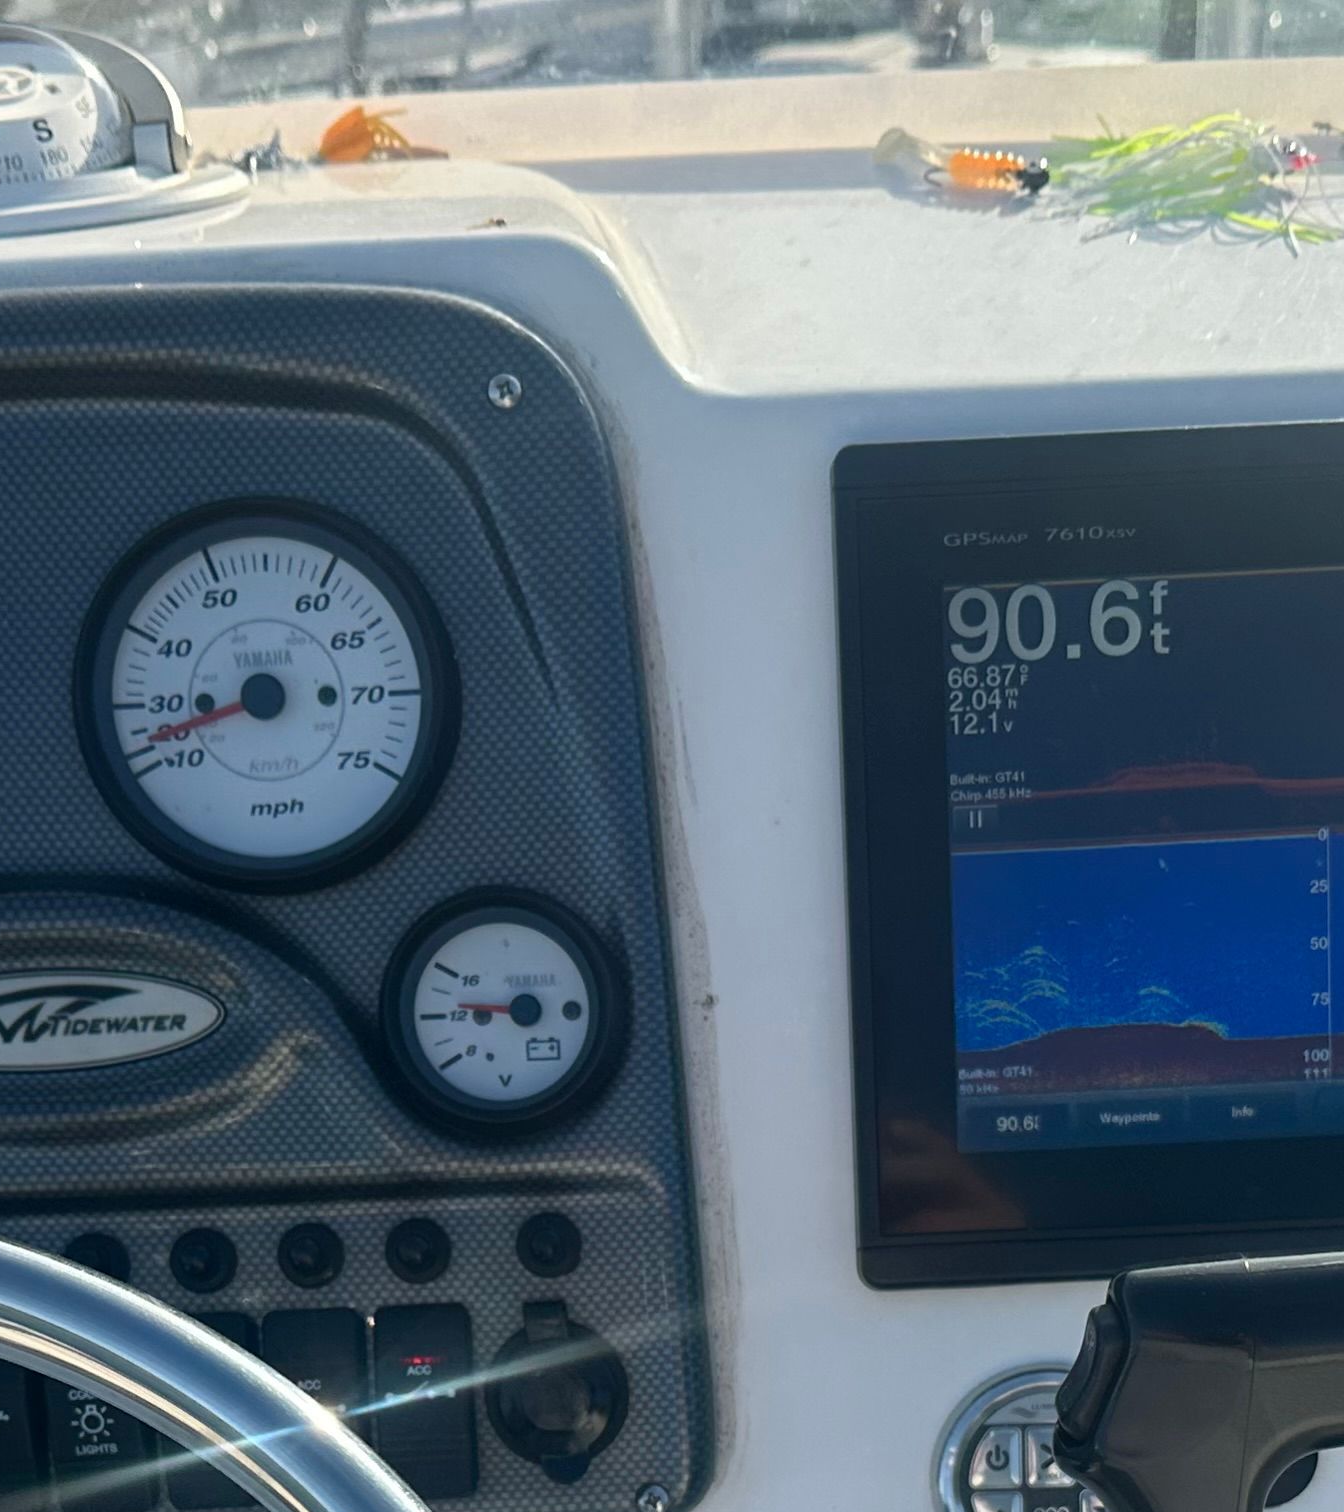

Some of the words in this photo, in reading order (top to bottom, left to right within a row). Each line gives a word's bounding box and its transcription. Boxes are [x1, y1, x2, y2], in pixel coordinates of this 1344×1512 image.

[33, 119, 53, 143] S
[202, 590, 237, 609] 50
[295, 594, 330, 613] 60
[947, 579, 1142, 664] 90.6
[157, 639, 191, 659] 40
[330, 631, 365, 650] 65
[233, 650, 293, 668] YAMAHA
[947, 664, 1016, 689] 66.87
[351, 685, 384, 705] 70
[949, 688, 1001, 713] 2.04
[148, 694, 184, 714] 30
[950, 711, 997, 735] 12.1
[250, 757, 299, 774] km/h
[337, 751, 370, 770] 75
[995, 771, 1025, 784] GT41
[950, 790, 982, 804] Chirp
[985, 789, 1006, 800] 455
[1008, 787, 1031, 799] kHz
[250, 800, 304, 818] mph
[1317, 828, 1327, 842] 0
[1310, 879, 1328, 894] 25
[1310, 936, 1328, 951] 50
[461, 975, 480, 986] 16
[506, 974, 556, 988] YAMAHA
[1311, 992, 1329, 1006] 75
[449, 1010, 467, 1022] 12
[47, 1015, 187, 1037] TIDEWATER
[466, 1045, 477, 1057] 8
[1303, 1049, 1329, 1062] 100
[1003, 1066, 1032, 1078] GT41
[498, 1075, 512, 1087] V
[1231, 1105, 1254, 1118] Info
[407, 1364, 432, 1376] ACC
[76, 1443, 118, 1457] LIGHTS
